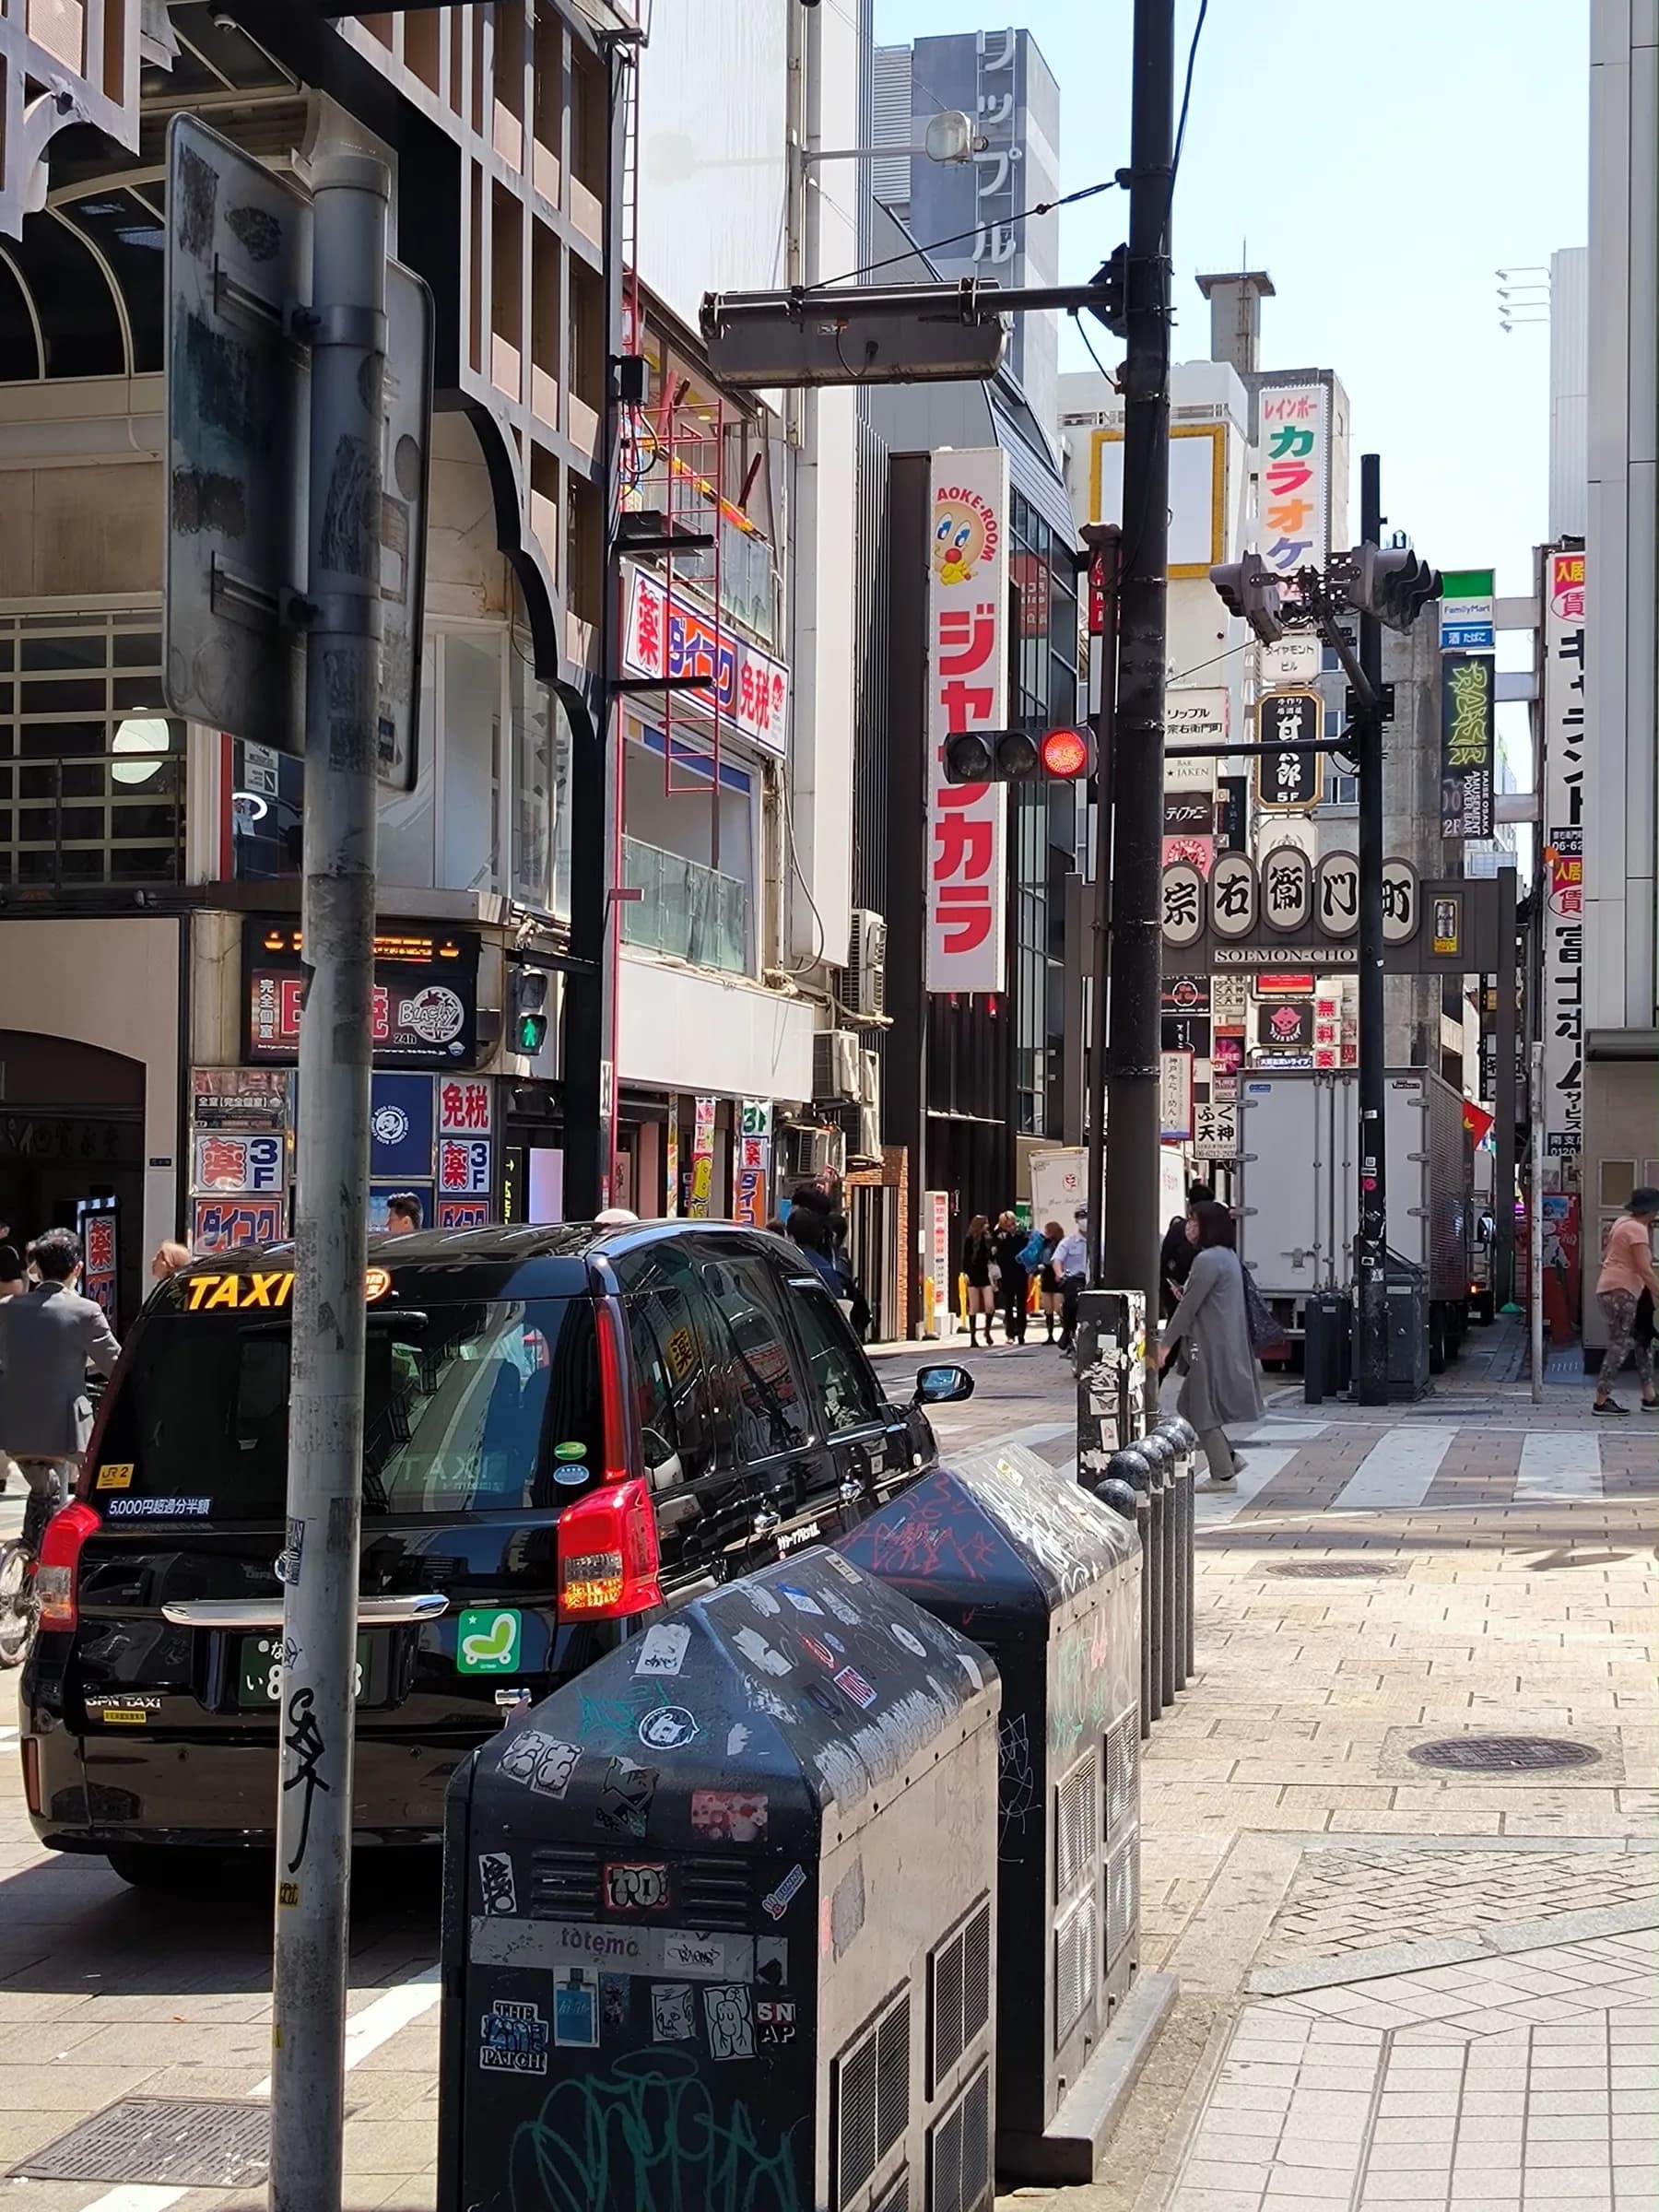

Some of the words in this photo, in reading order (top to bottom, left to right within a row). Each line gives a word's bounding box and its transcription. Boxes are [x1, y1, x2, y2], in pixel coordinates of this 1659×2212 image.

[975, 27, 1023, 265] リップル
[1265, 425, 1314, 571] カラオケ
[1444, 603, 1490, 616] FamilyMart
[637, 578, 660, 671] 薬
[740, 657, 770, 731] 免税
[1277, 792, 1300, 803] 5F
[1216, 948, 1357, 962] SOEMON-CHO
[394, 1033, 418, 1044] 24h
[442, 1082, 489, 1128] 免税
[1197, 1124, 1234, 1142] 天神
[204, 1136, 245, 1188] 薬
[442, 1140, 468, 1189] 薬
[88, 1219, 113, 1270] 薬
[202, 1206, 276, 1248] ダイコク
[188, 1272, 295, 1311] TAXI
[495, 2003, 535, 2022] THE
[483, 2047, 543, 2071] PATCH
